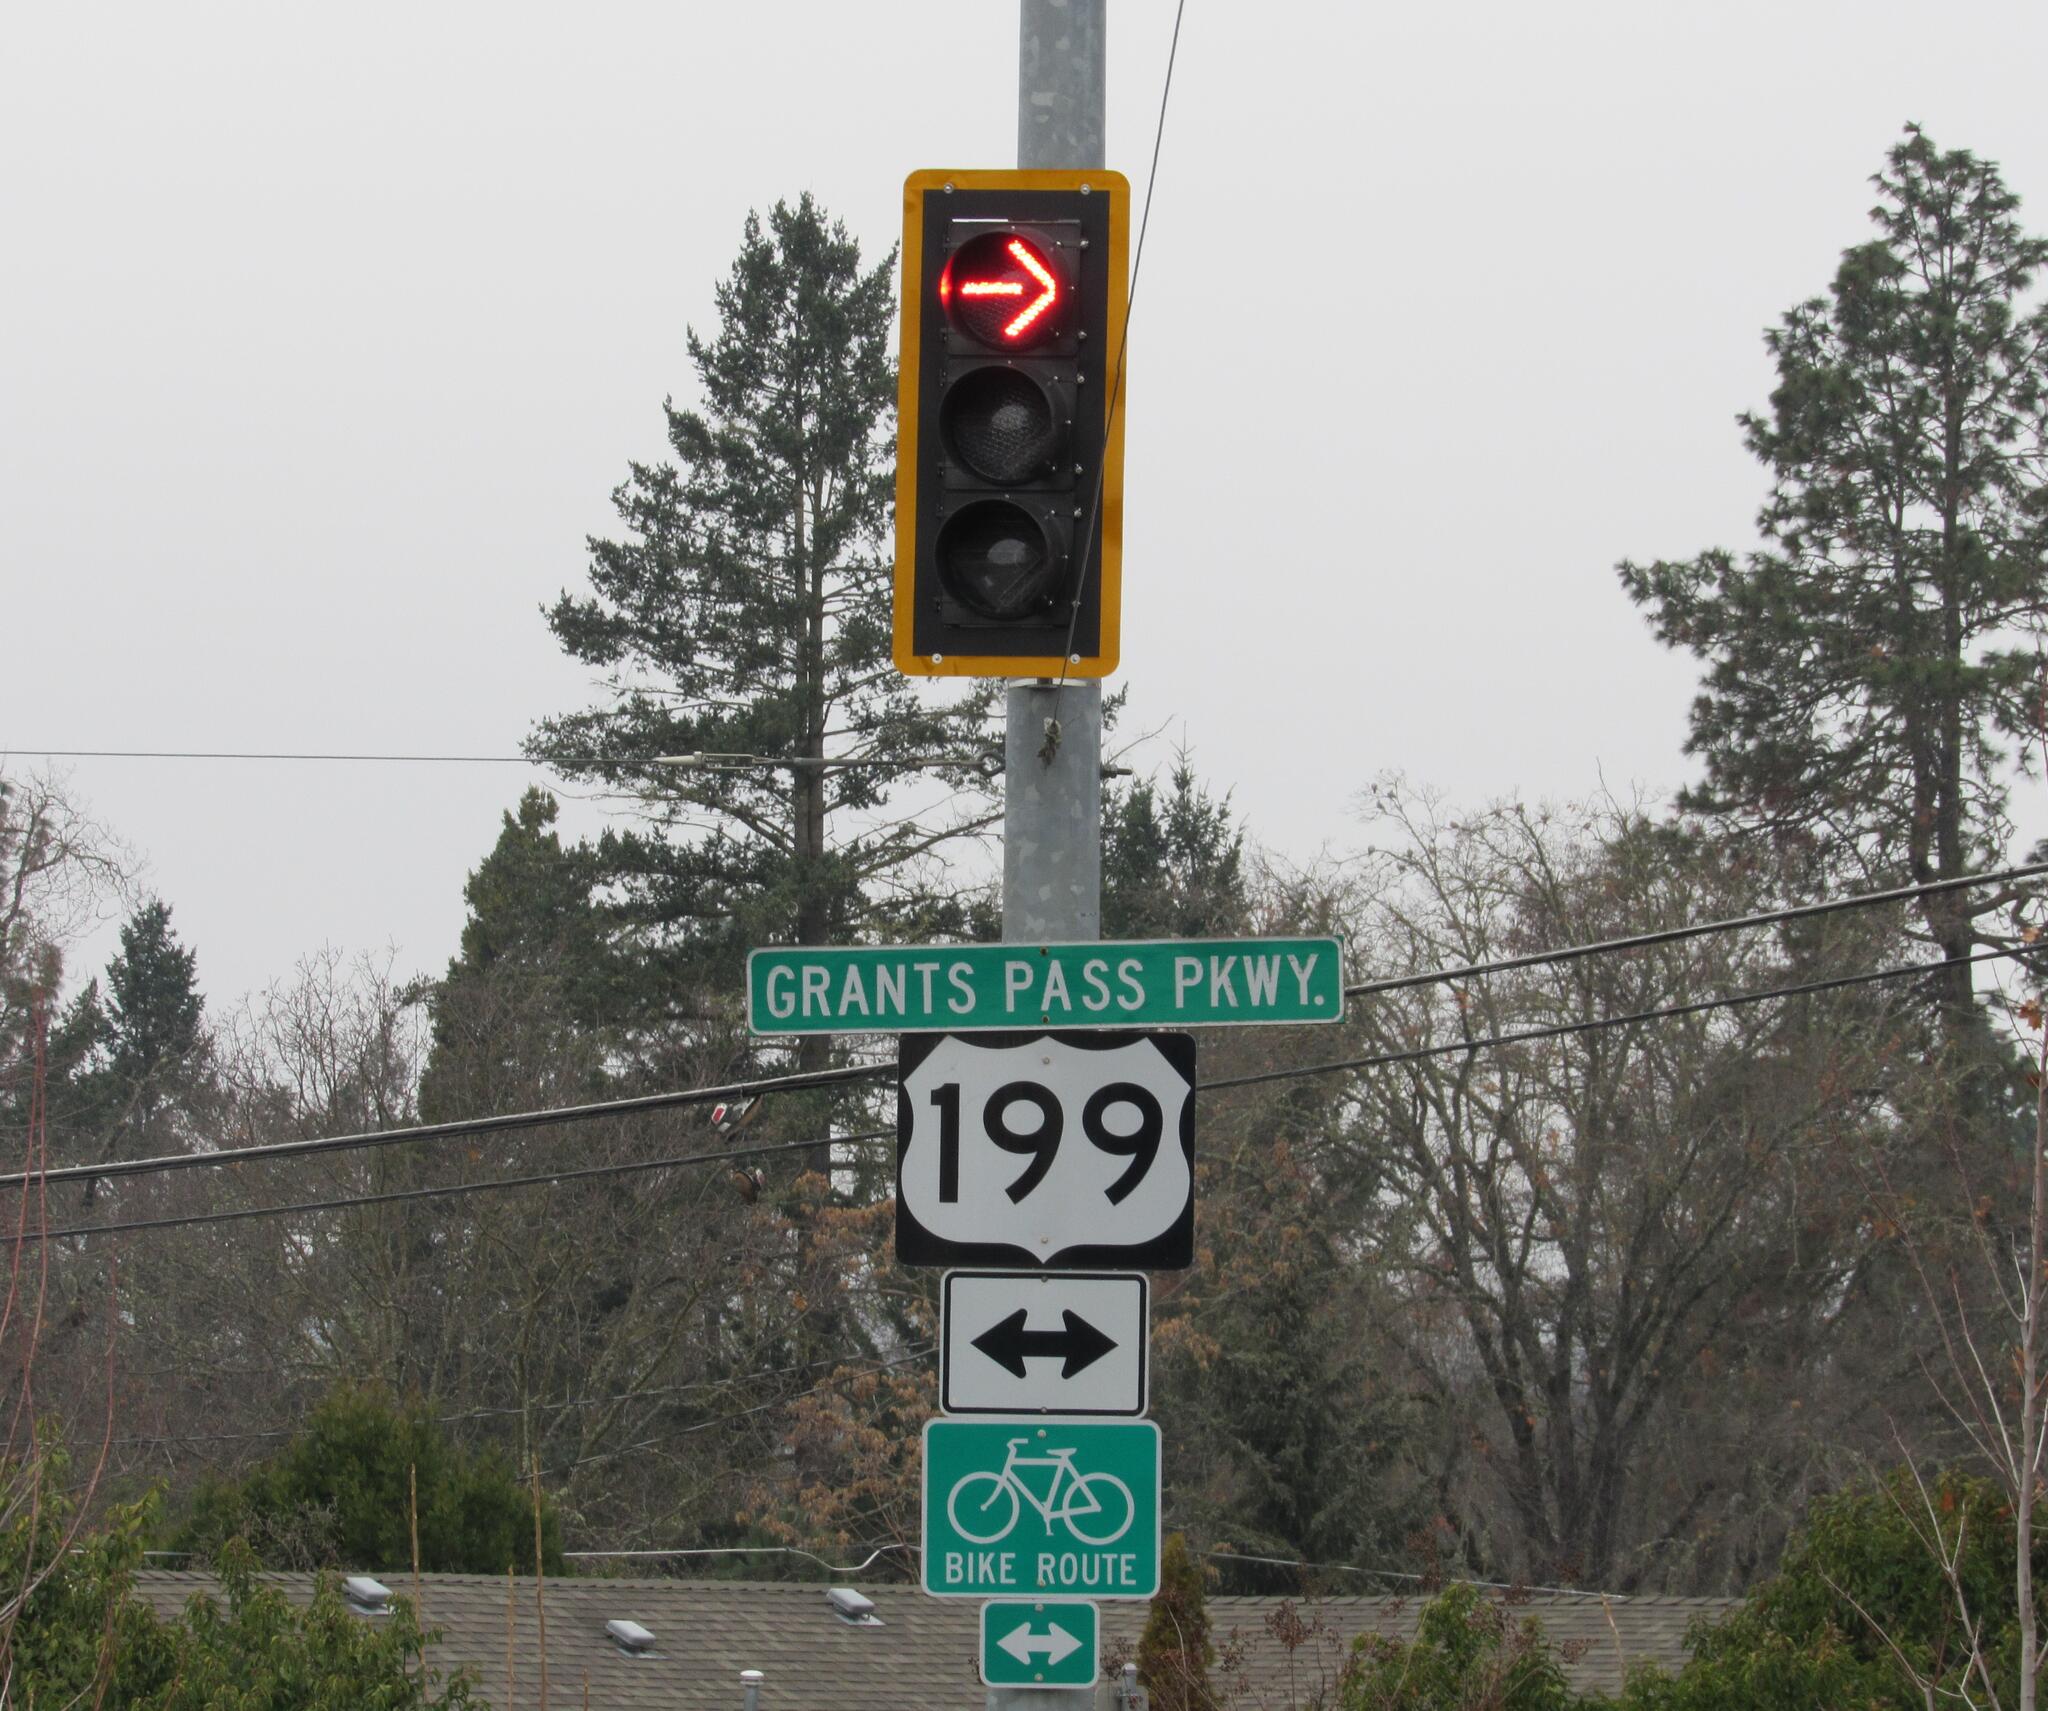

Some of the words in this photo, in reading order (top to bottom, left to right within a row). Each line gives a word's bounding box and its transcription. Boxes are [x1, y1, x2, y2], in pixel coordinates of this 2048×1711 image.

[766, 962, 977, 1018] GRANTS
[1005, 959, 1145, 1012] PASS
[1175, 953, 1326, 1009] PKWY.
[930, 1080, 1164, 1207] 199
[946, 1552, 1016, 1584] BIKE
[1038, 1553, 1137, 1586] ROUTE
